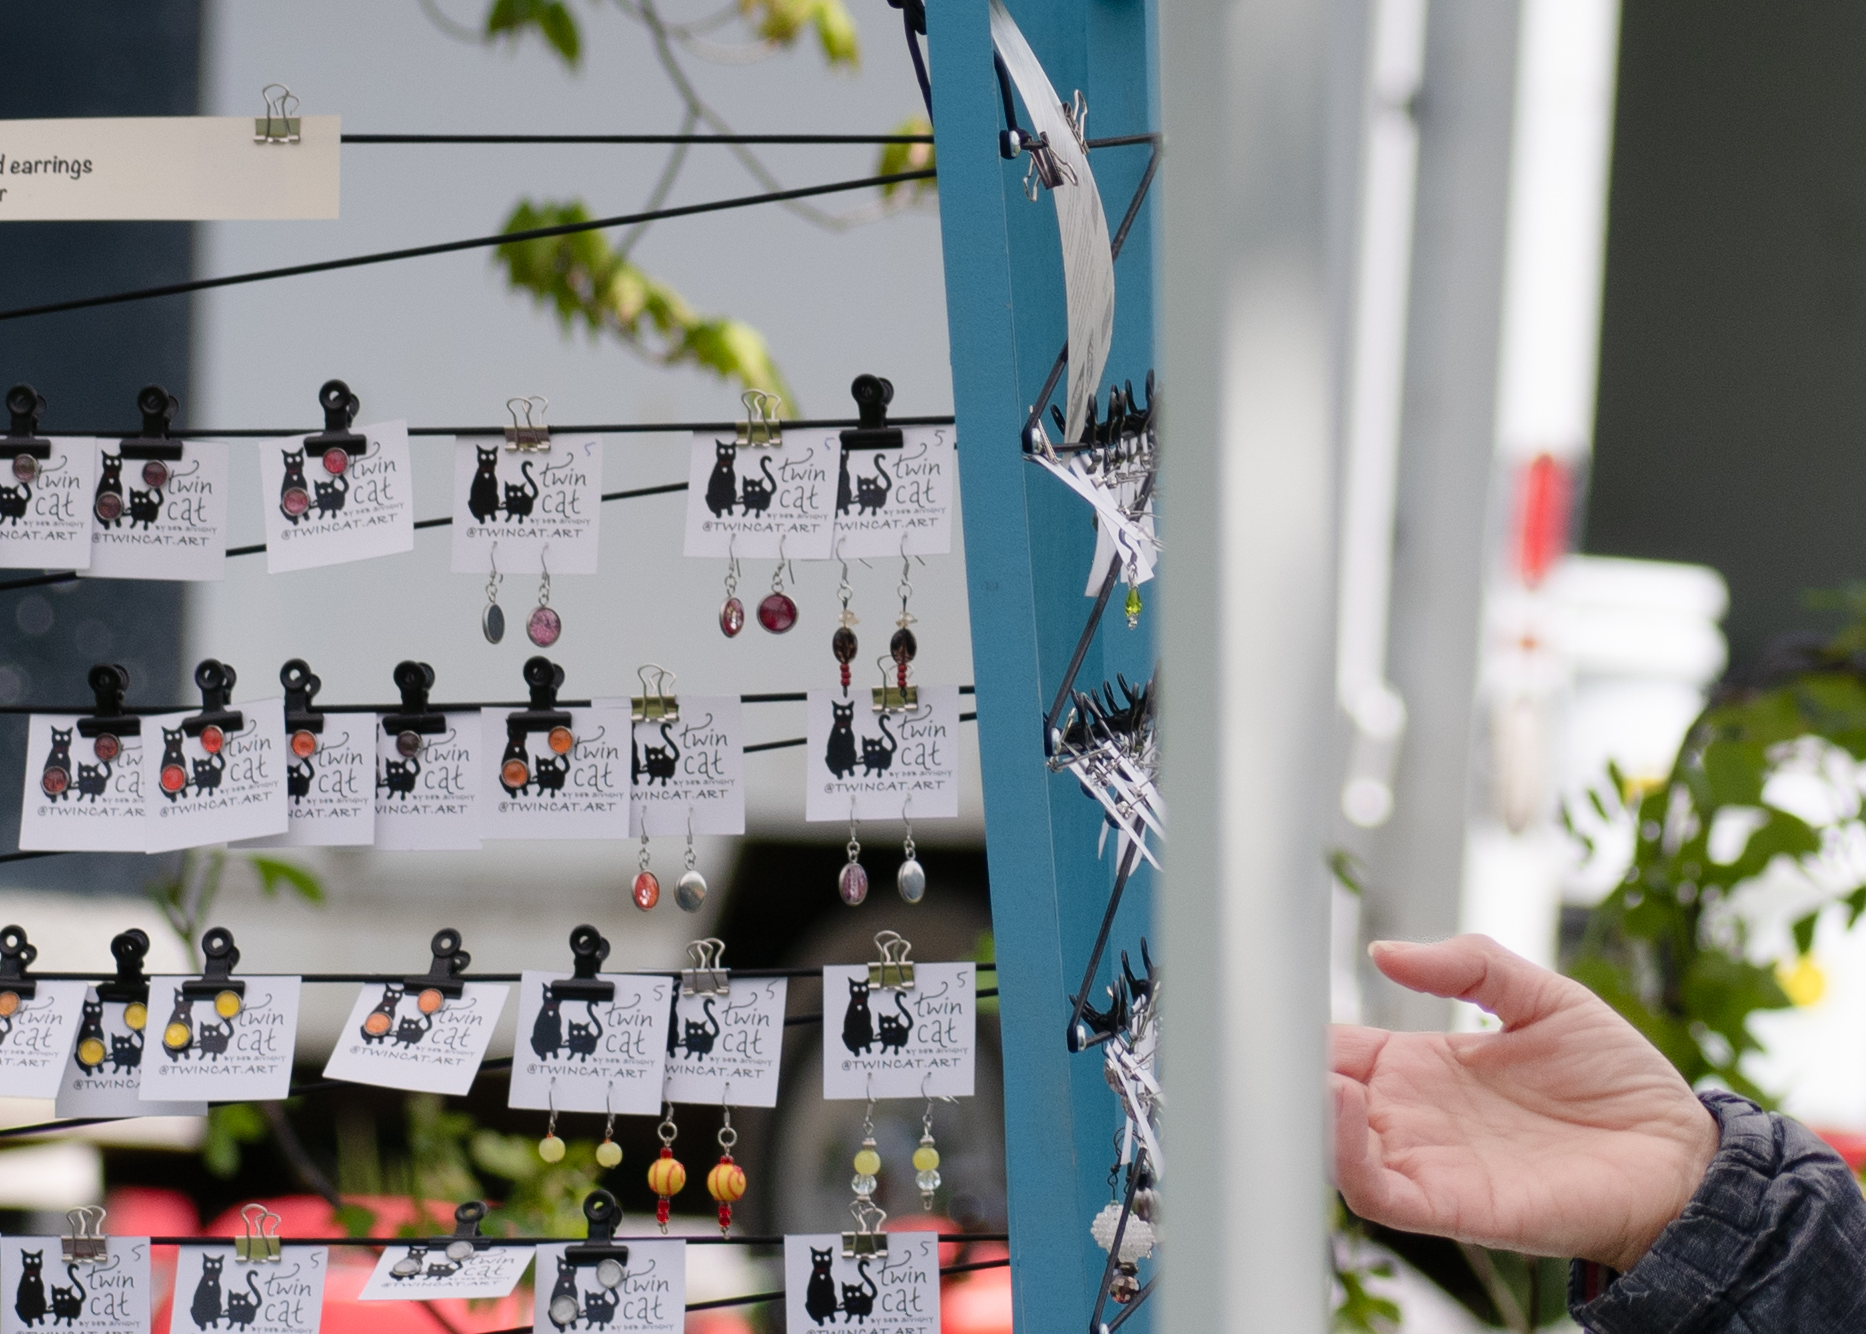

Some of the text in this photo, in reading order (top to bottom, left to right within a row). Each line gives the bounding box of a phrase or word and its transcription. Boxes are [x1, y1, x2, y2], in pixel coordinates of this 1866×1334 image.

[10, 155, 93, 181] earrings
[583, 442, 596, 457] 5
[934, 430, 946, 447] 5
[32, 454, 81, 491] twin
[347, 441, 397, 480] twin
[538, 451, 587, 488] twin
[777, 447, 826, 483] twin
[891, 442, 941, 480] twin
[164, 459, 213, 496] twin
[353, 475, 394, 506] cat
[34, 491, 75, 522] cat
[541, 488, 581, 520] cat
[779, 483, 819, 515] cat
[895, 478, 936, 509] cat
[166, 496, 207, 528] cat
[281, 513, 398, 540] @TWINCAT.ART
[702, 520, 821, 533] @TWINCAT.ART
[91, 532, 209, 546] @TWINCAT.ART
[466, 526, 583, 538] @TWINCAT.ART
[678, 712, 729, 750] twin
[896, 703, 947, 741] twin
[224, 718, 272, 758] twin
[314, 731, 364, 768] twin
[420, 728, 470, 765] twin
[569, 725, 619, 762] twin
[229, 753, 269, 784] cat
[683, 749, 725, 780] cat
[900, 740, 942, 772] cat
[115, 766, 146, 797] ca
[317, 767, 358, 799] cat
[424, 764, 465, 796] cat
[573, 762, 614, 793] cat
[824, 780, 945, 794] @TWINCAT.ART
[159, 791, 272, 818] @TWINCAT.ART
[498, 801, 617, 813] @TWINCAT.ART
[630, 789, 728, 801] WINCAT.ART
[38, 805, 146, 817] @TWINCAT.AR
[653, 985, 665, 1001] 5
[956, 971, 968, 987] 5
[15, 996, 64, 1026] twin
[235, 993, 284, 1028] twin
[437, 997, 484, 1027] twin
[603, 992, 653, 1028] twin
[720, 991, 770, 1027] twin
[912, 980, 963, 1018] twin
[12, 1026, 53, 1052] cat
[236, 1027, 277, 1057] cat
[430, 1026, 471, 1051] cat
[605, 1029, 646, 1060] cat
[722, 1028, 763, 1060] cat
[916, 1017, 958, 1049] cat
[158, 1064, 278, 1076] @TWINCAT.ART
[349, 1046, 465, 1066] @TWINCAT.ART
[526, 1063, 647, 1078] @TWINCAT.ART
[664, 1064, 764, 1078] WINCAT.ART
[841, 1057, 961, 1071] @TWINCAT.ART
[131, 1244, 145, 1261] 5
[311, 1251, 323, 1269] 5
[919, 1240, 931, 1256] 5
[85, 1254, 135, 1291] twin
[263, 1262, 312, 1298] twin
[619, 1258, 670, 1295] twin
[876, 1249, 927, 1287] twin
[89, 1290, 131, 1322] cat
[264, 1298, 304, 1329] cat
[622, 1294, 664, 1325] cat
[881, 1286, 923, 1318] cat
